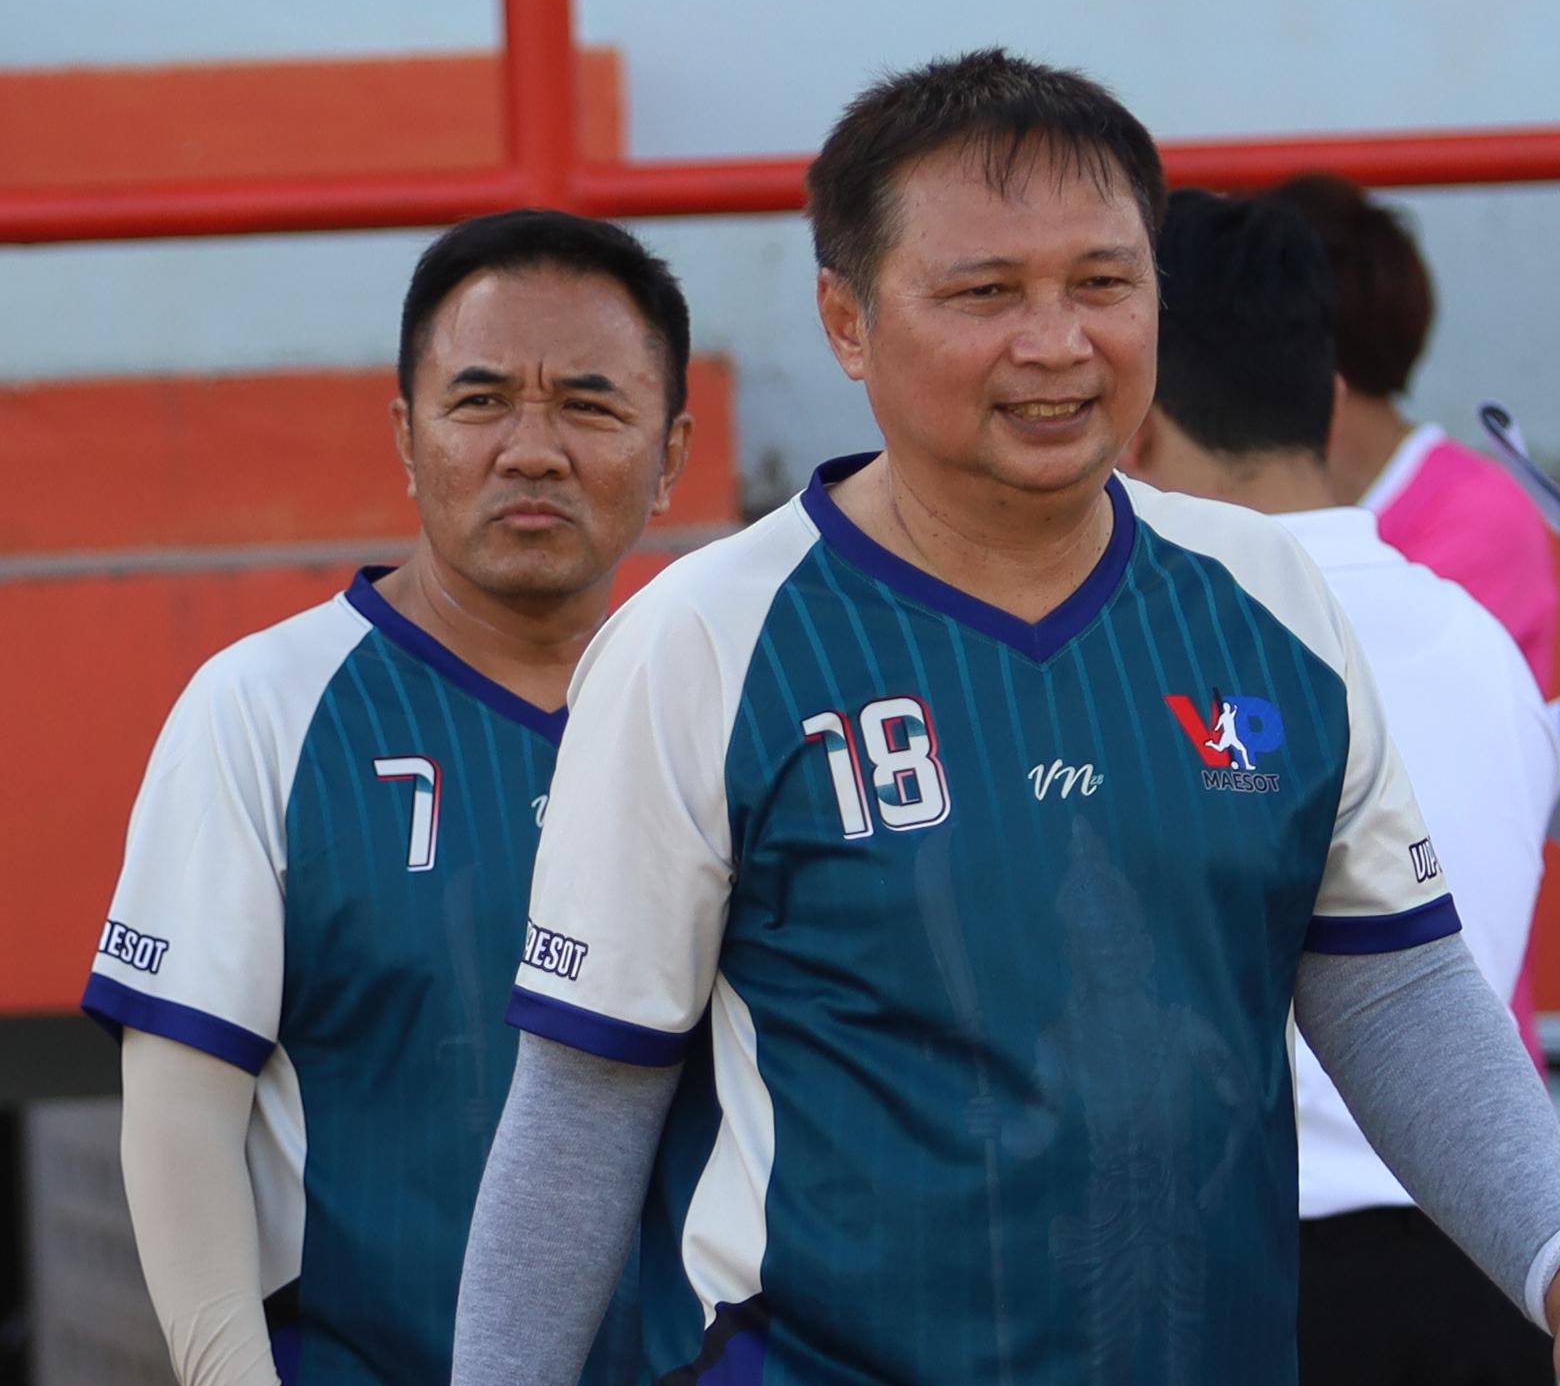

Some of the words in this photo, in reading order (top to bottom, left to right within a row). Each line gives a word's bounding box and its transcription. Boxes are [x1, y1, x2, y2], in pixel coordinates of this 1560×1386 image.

[373, 753, 443, 873] 7
[799, 693, 953, 840] 18
[1200, 769, 1280, 794] MAESOT
